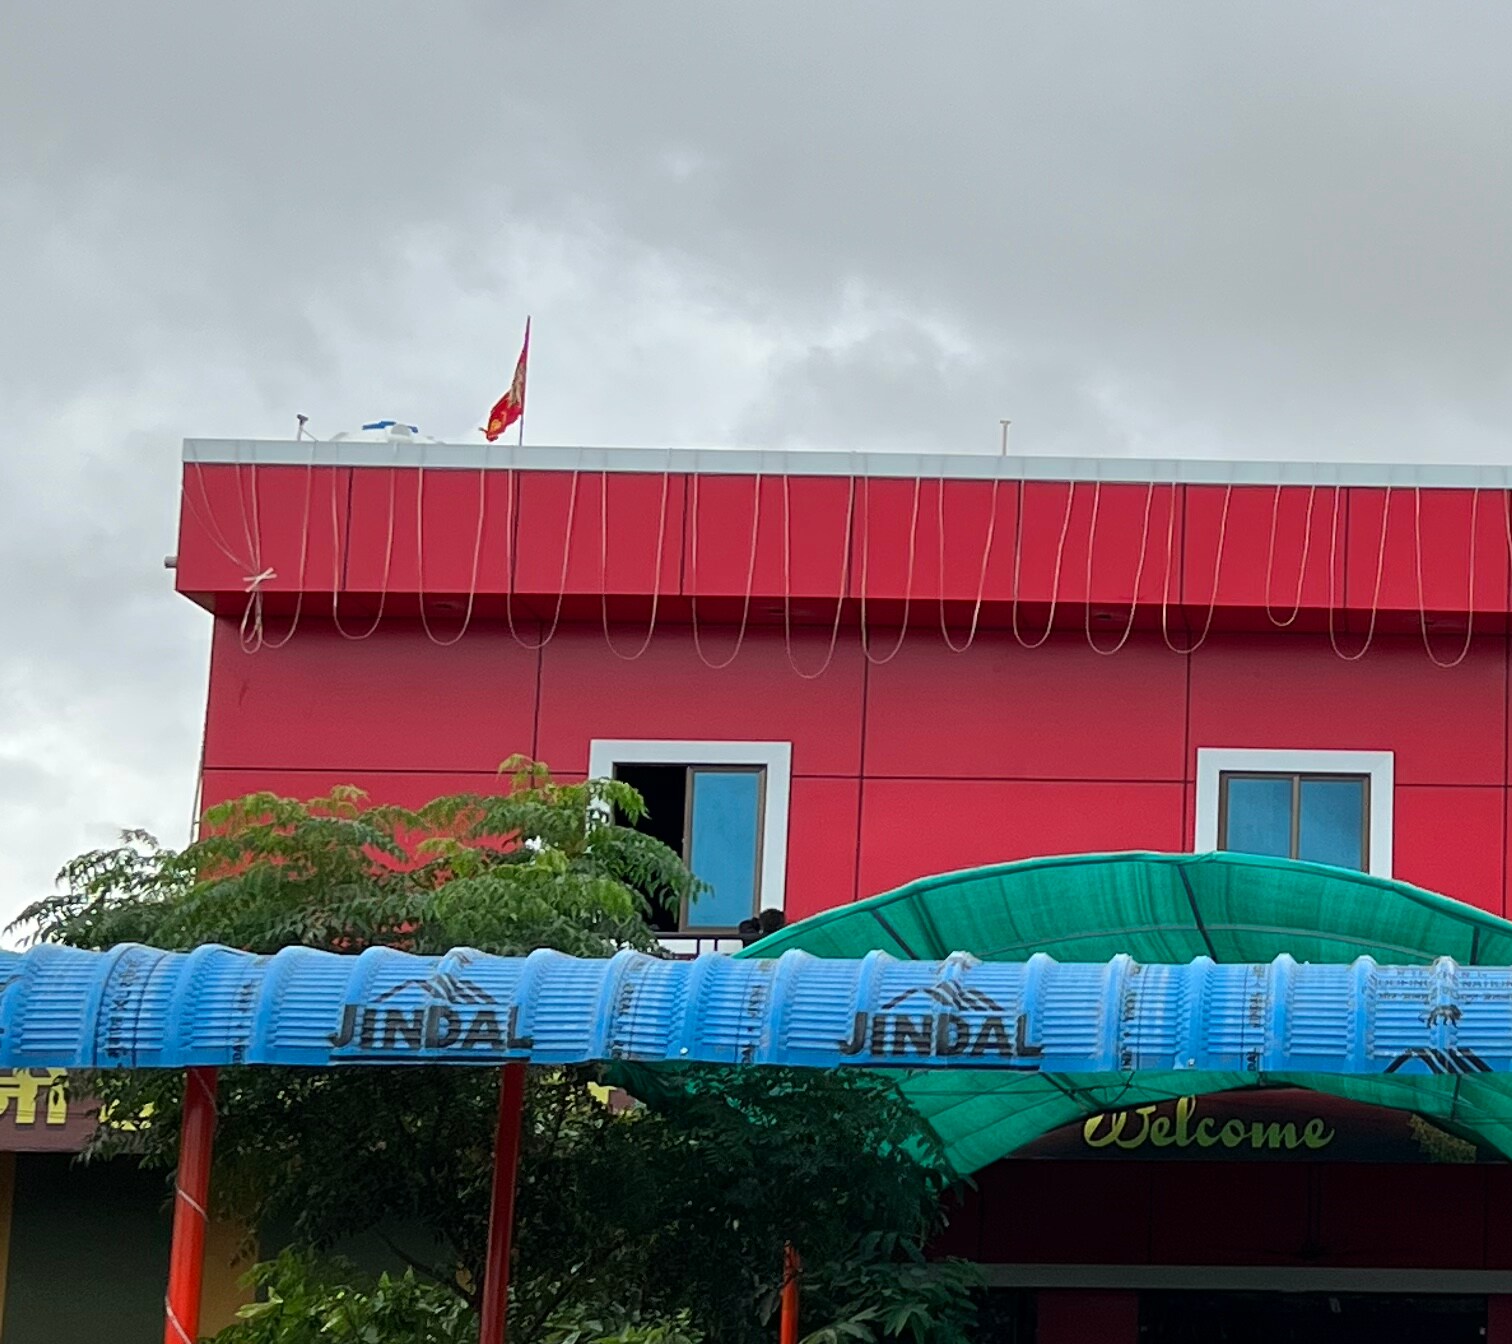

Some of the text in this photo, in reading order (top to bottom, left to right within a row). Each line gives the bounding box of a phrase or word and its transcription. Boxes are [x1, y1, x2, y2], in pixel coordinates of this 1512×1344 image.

[327, 1003, 534, 1050] JINDAL
[837, 1011, 1044, 1057] JINDAL
[1083, 1093, 1336, 1149] Welcome
